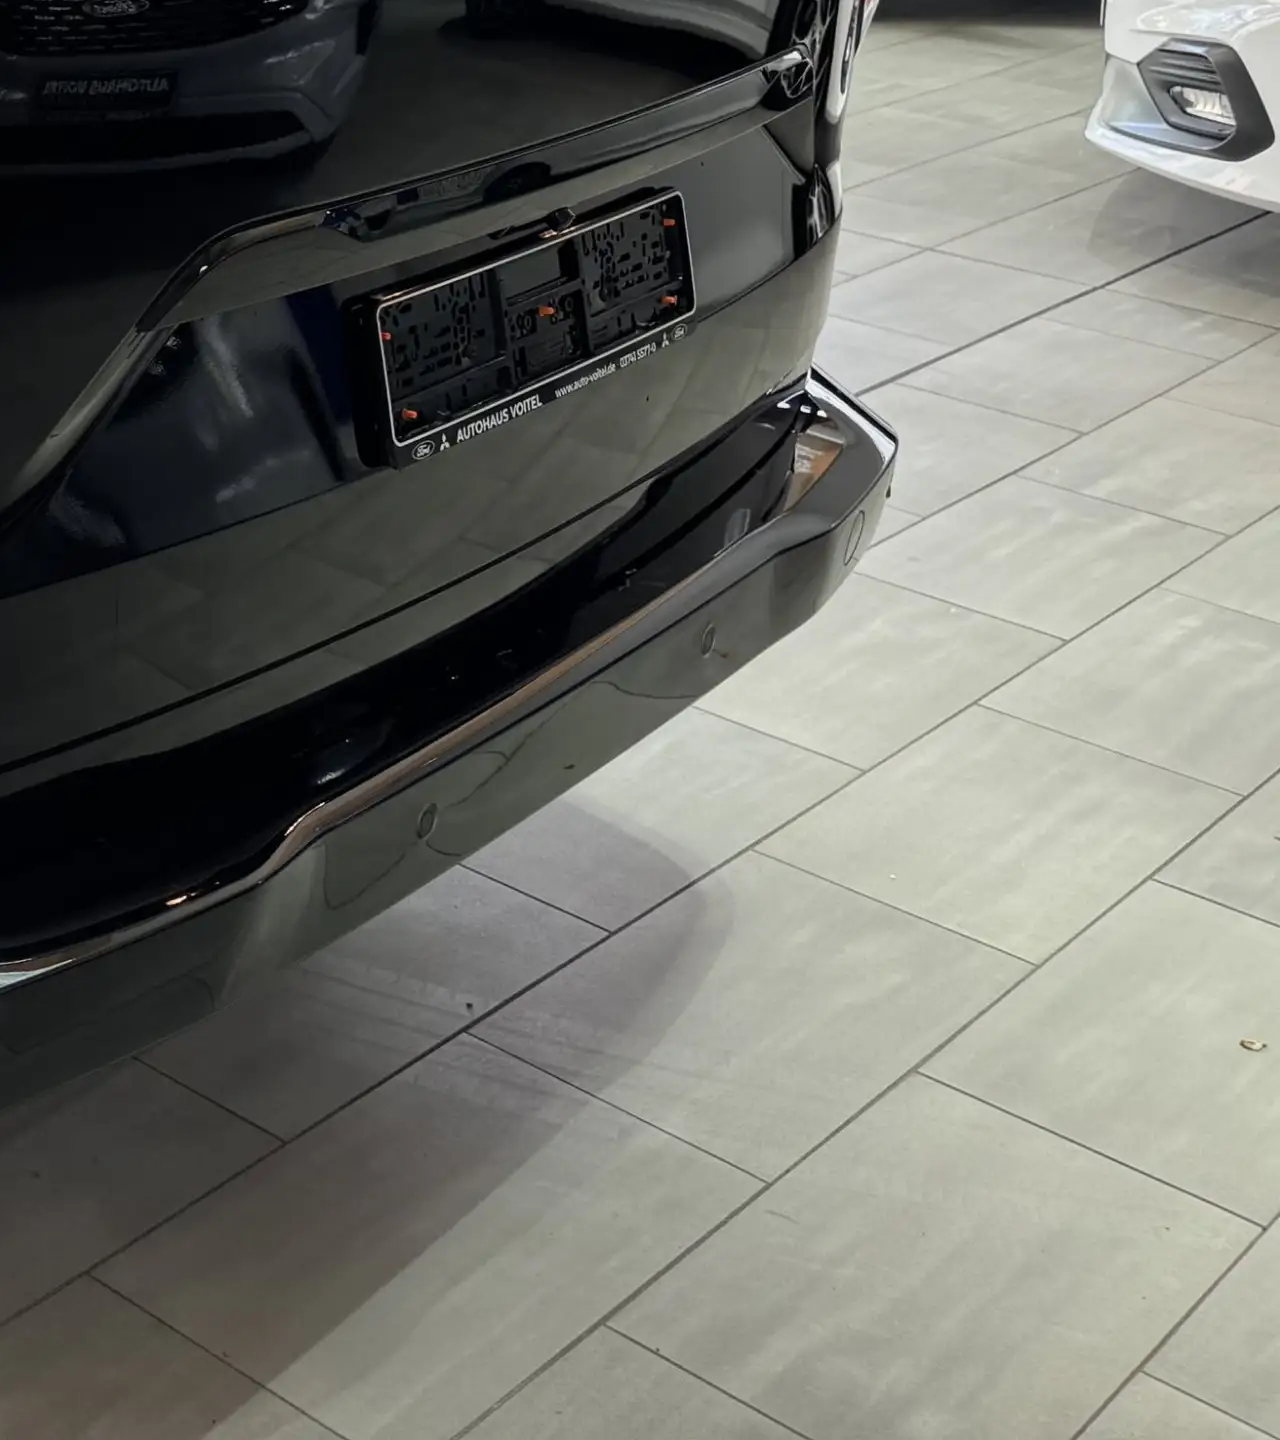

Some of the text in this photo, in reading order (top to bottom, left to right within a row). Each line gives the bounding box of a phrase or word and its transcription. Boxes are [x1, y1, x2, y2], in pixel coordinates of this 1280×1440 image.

[456, 408, 509, 443] AUTOHAUS
[510, 394, 543, 419] VOITEL
[555, 362, 616, 399] www.auto-voitel.de
